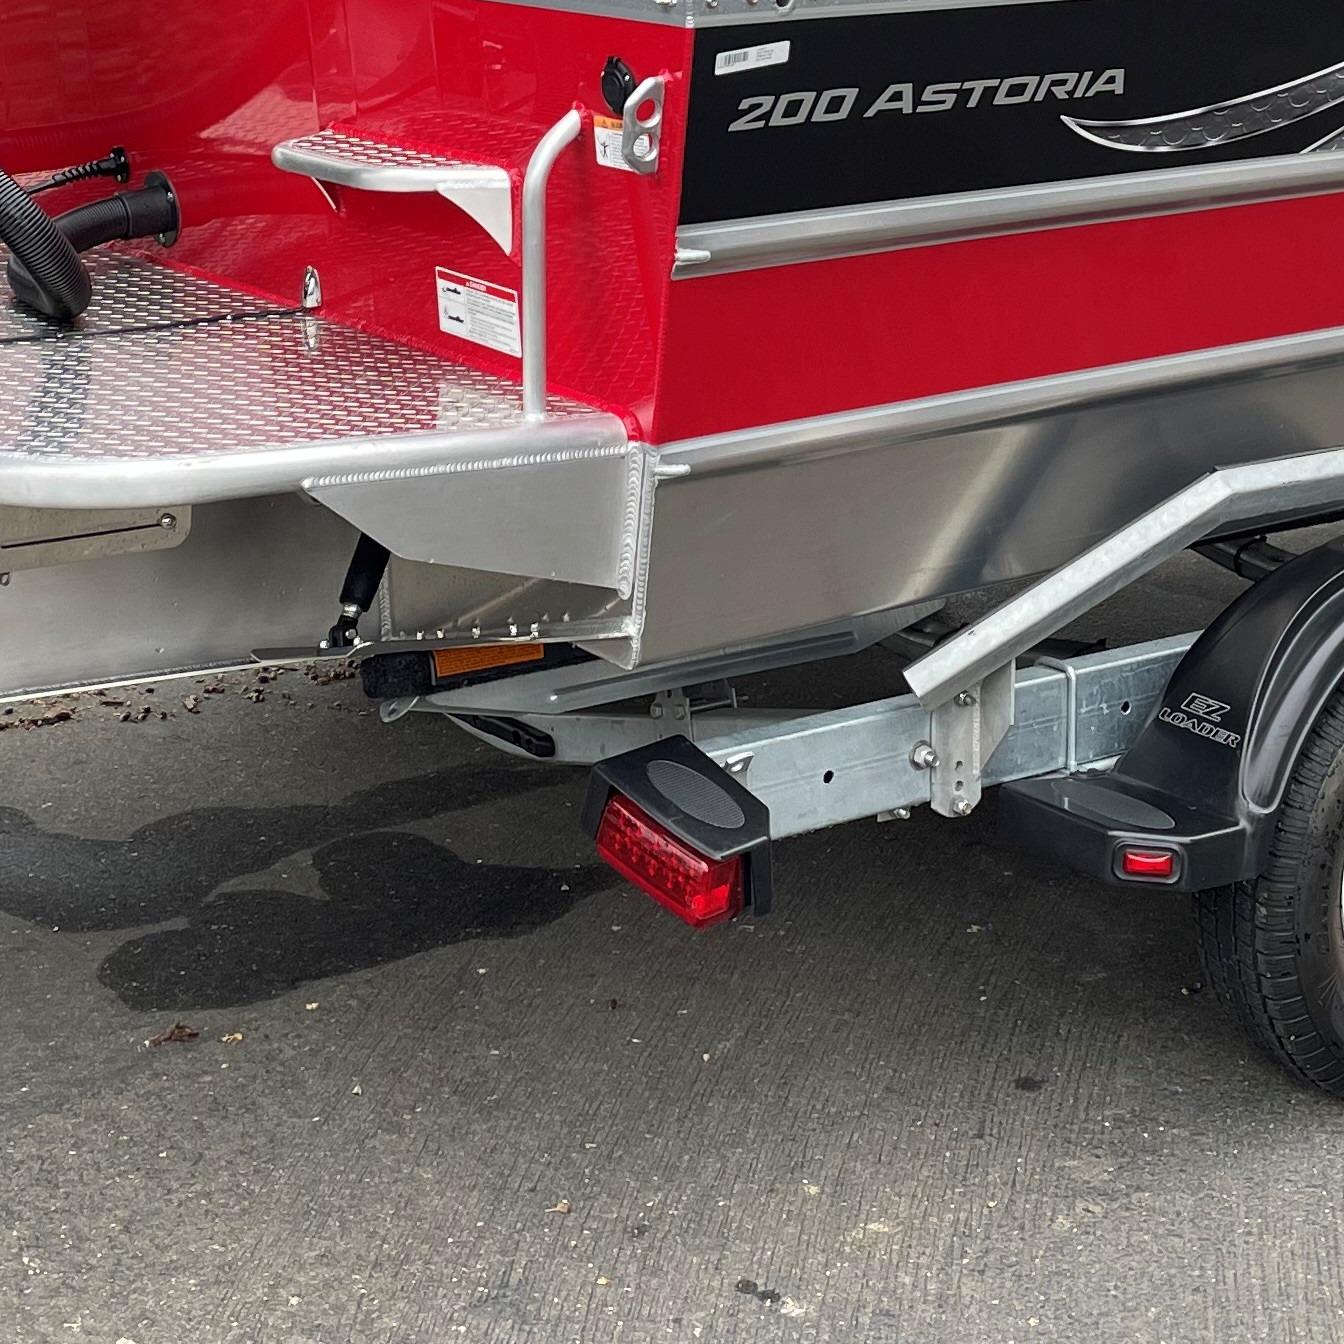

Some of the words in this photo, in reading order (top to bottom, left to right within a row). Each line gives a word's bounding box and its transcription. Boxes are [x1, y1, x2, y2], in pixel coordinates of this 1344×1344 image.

[728, 88, 860, 132] 200
[864, 68, 1125, 117] ASTORIA
[1158, 707, 1241, 748] LOADER
[1181, 692, 1231, 722] EZ
